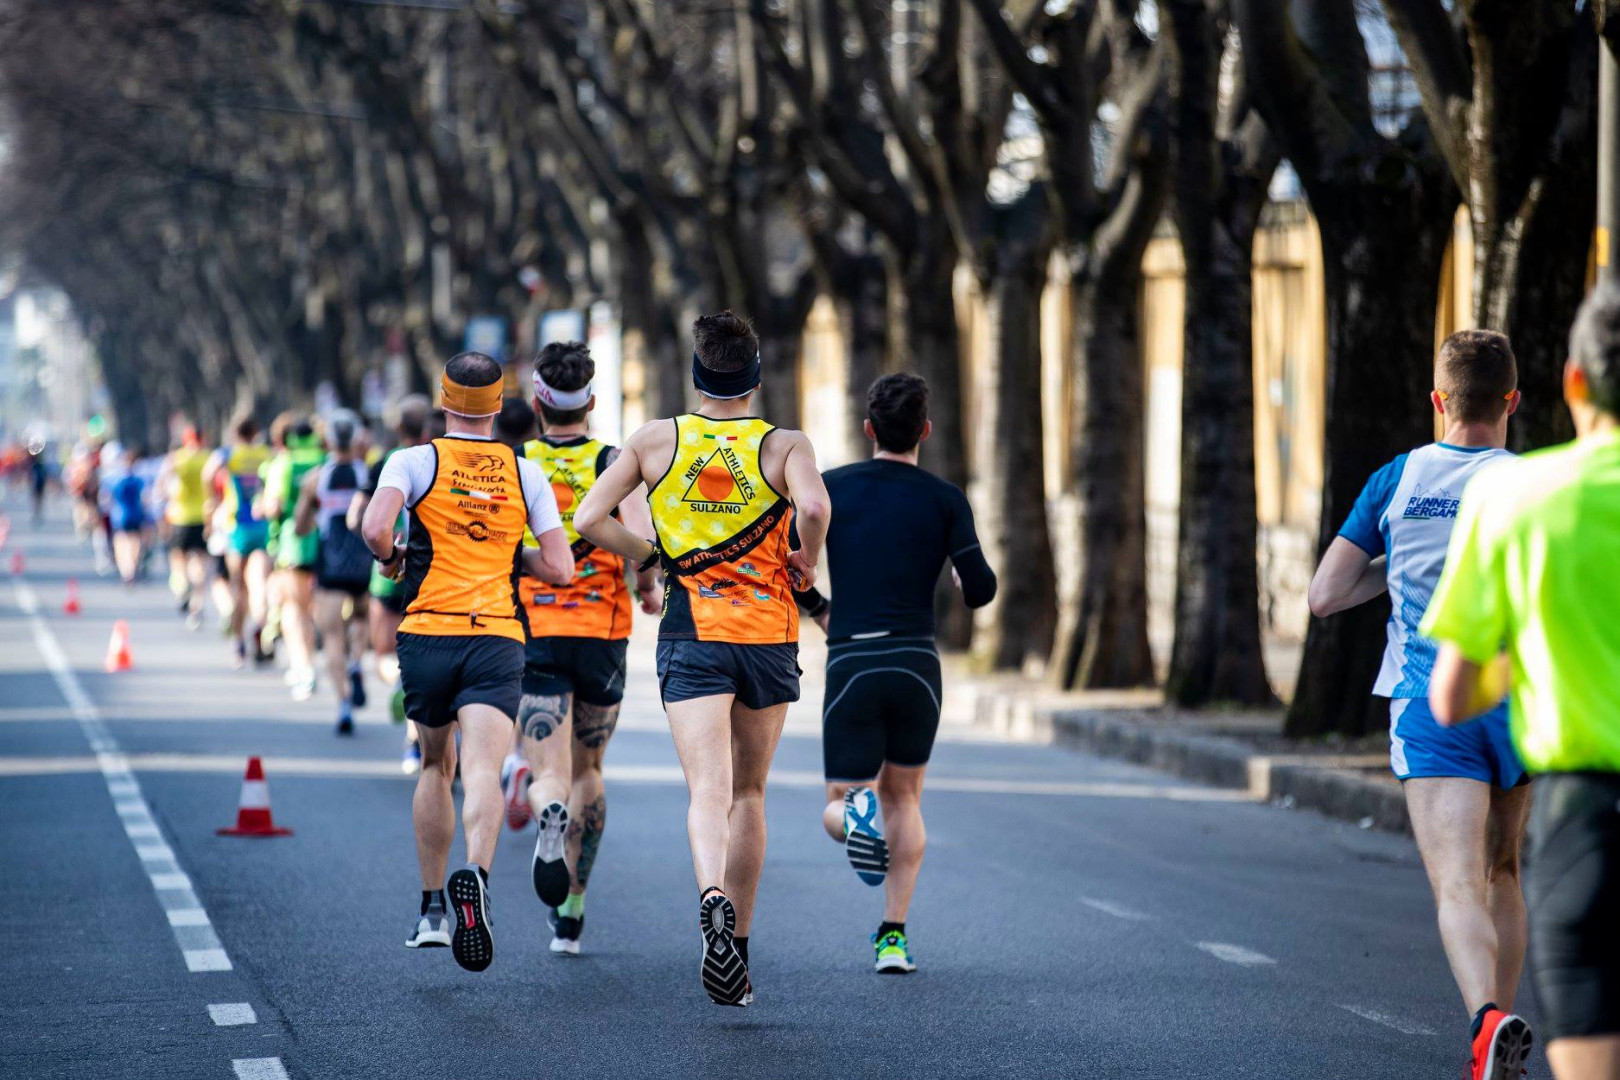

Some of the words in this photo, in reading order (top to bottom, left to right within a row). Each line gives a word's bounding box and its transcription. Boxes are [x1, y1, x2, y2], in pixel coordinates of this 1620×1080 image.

[685, 456, 705, 481] NEW
[723, 447, 756, 501] ATHLETICS
[451, 470, 506, 483] ATLETICA
[457, 500, 487, 511] Allianz
[690, 503, 741, 515] SULZANO
[1408, 497, 1461, 509] RUNNER
[1403, 506, 1458, 518] BERGAM
[739, 515, 775, 548] SULZANO
